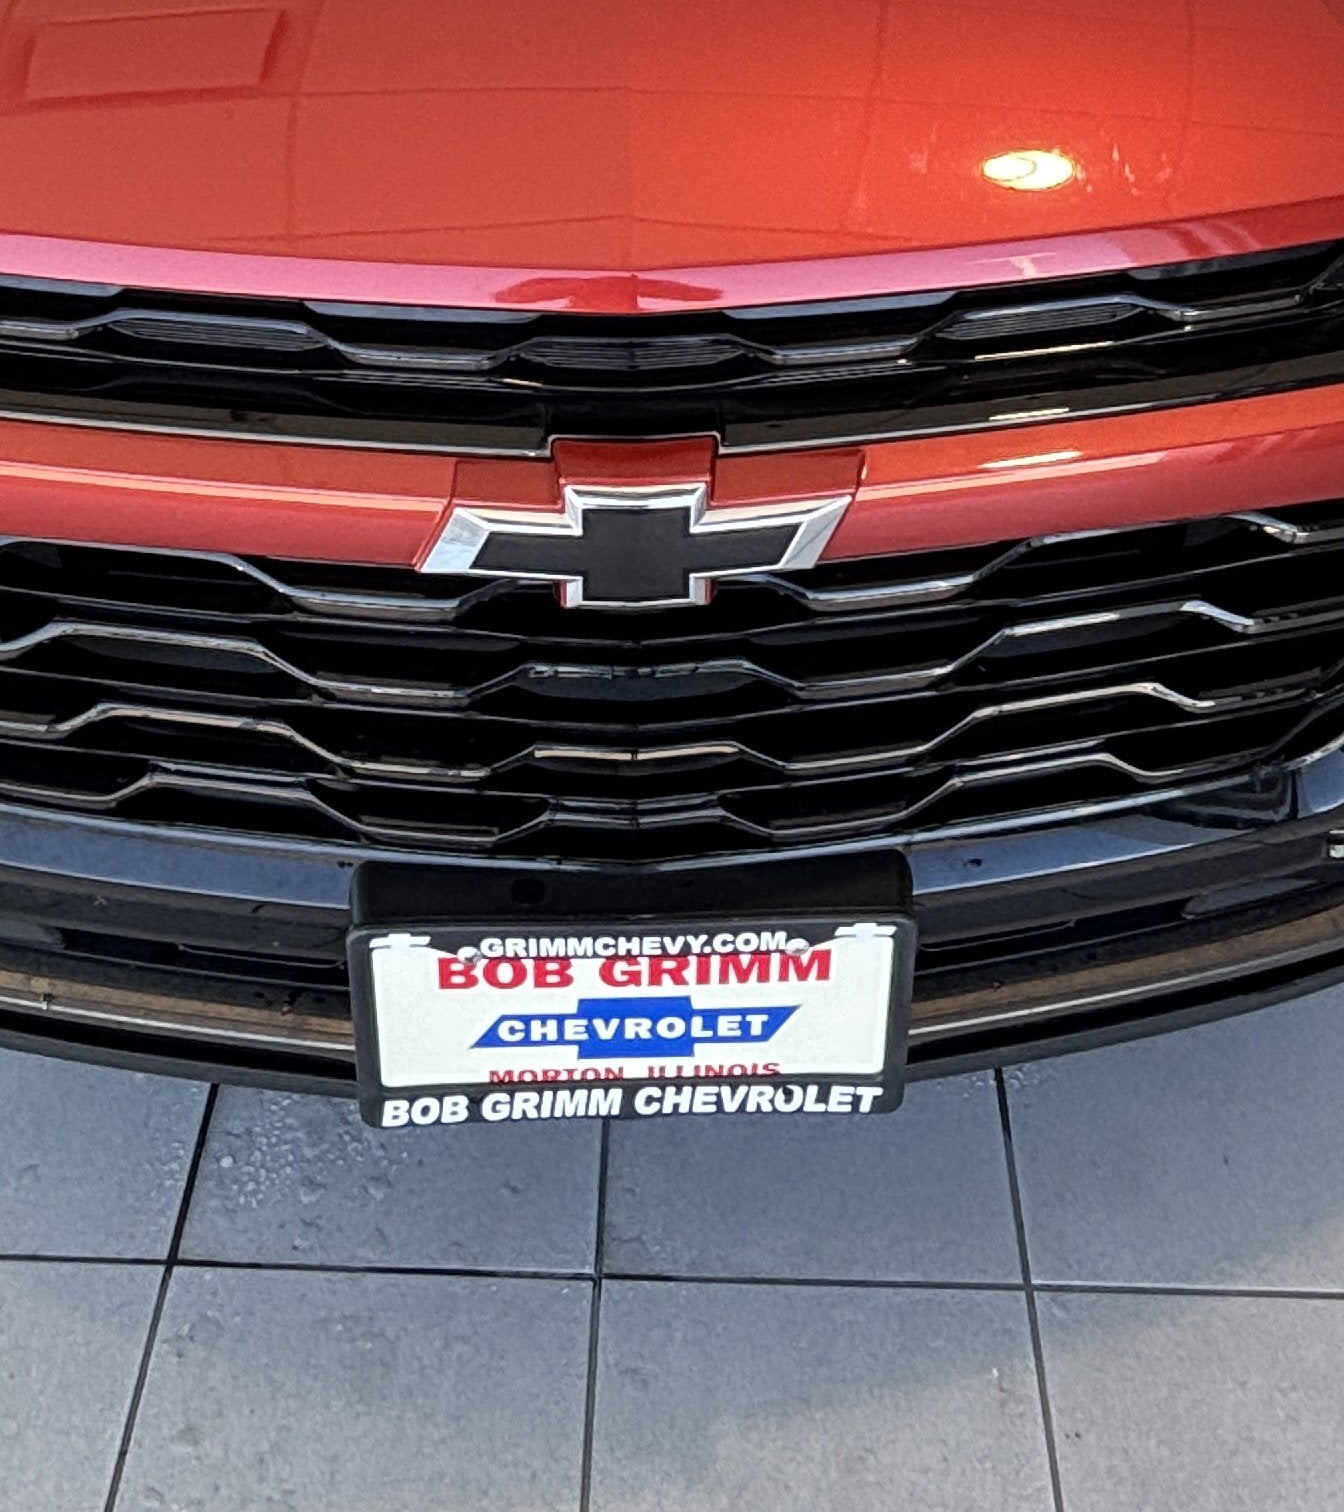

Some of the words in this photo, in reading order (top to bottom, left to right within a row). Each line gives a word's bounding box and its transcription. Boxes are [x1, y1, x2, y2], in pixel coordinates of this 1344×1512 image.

[479, 931, 786, 959] GRIMMCHEVY.COM
[437, 953, 574, 990] BOB
[599, 949, 832, 988] GRIMM
[497, 1013, 770, 1043] CHEVROLET
[380, 1098, 469, 1128] BOB
[481, 1090, 622, 1121] GRIMM
[634, 1084, 884, 1118] CHEVROLET
